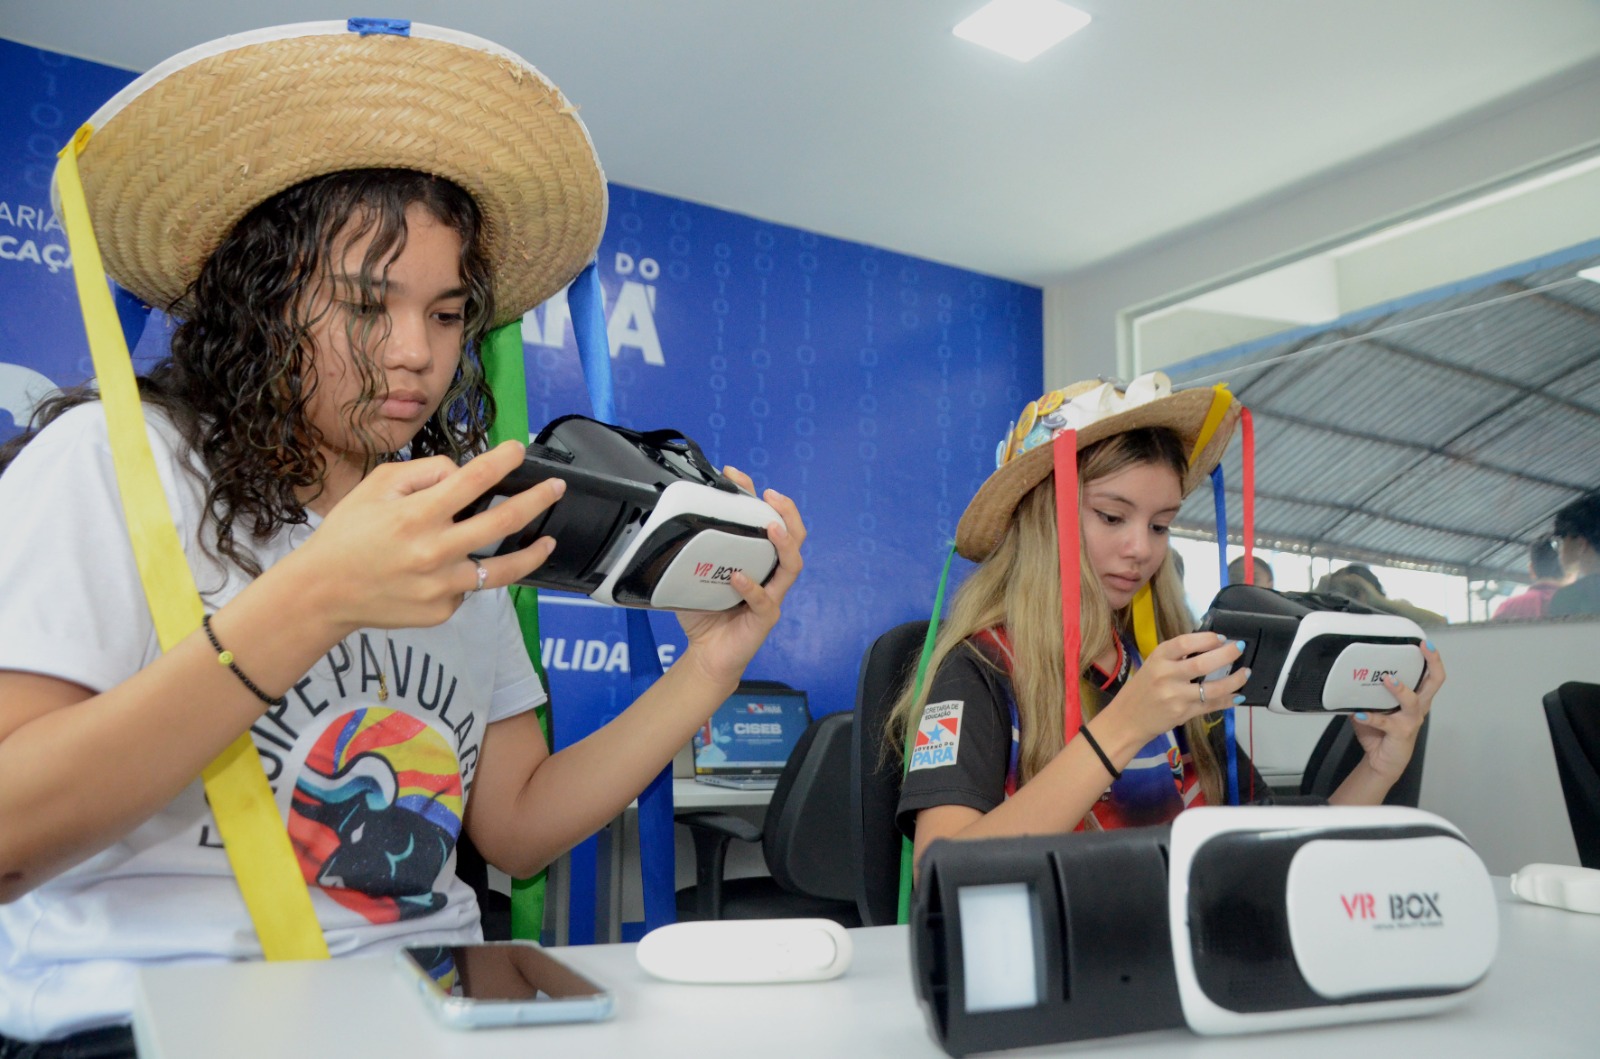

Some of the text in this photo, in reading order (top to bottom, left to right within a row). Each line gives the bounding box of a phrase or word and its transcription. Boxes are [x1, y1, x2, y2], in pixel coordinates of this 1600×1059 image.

[0, 234, 72, 274] CAÇ
[614, 252, 660, 281] DO
[694, 562, 713, 577] VR
[540, 637, 676, 673] ILIDAE
[1353, 668, 1369, 681] VR
[326, 633, 478, 791] PAVULAG
[733, 722, 782, 735] CISEB
[1340, 892, 1442, 920] VR BOX
